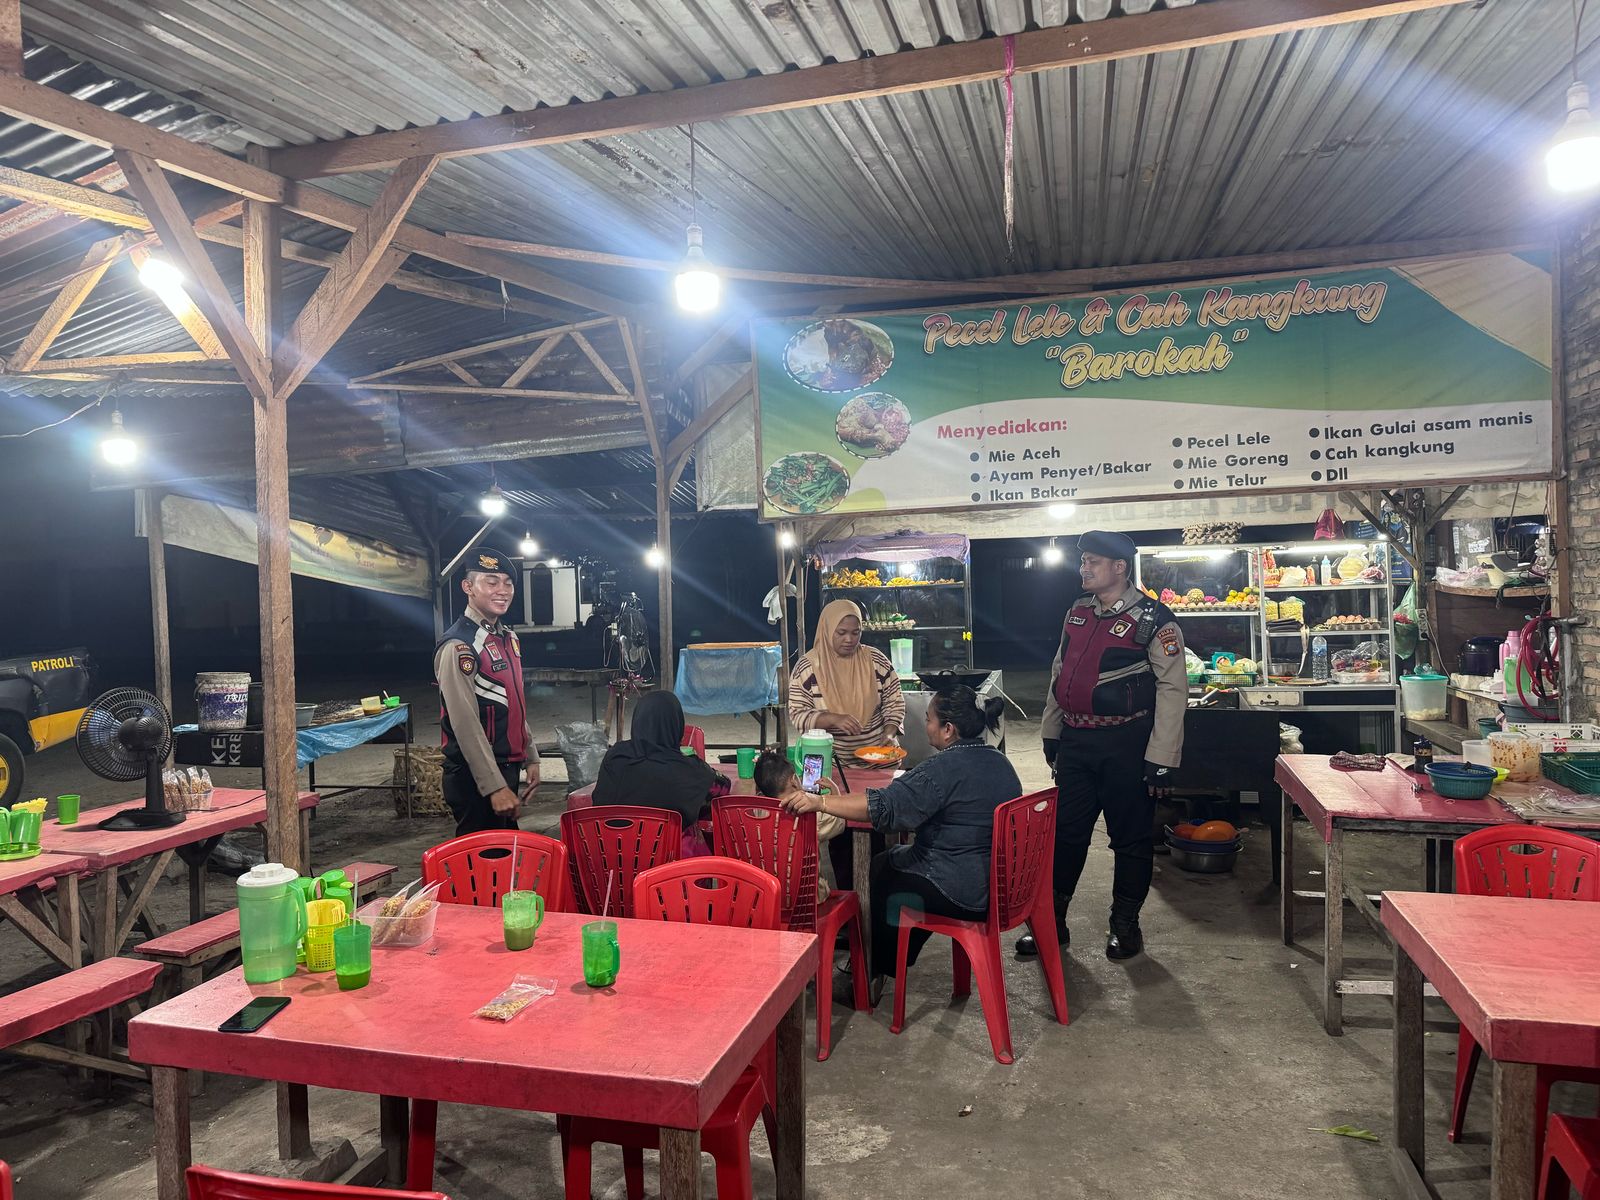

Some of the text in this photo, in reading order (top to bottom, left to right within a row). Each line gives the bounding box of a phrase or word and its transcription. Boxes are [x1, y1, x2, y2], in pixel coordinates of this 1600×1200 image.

[923, 278, 1388, 354] Pecel Lele & Cah Kangkung
[936, 419, 1068, 441] Menyediakan:
[1324, 411, 1533, 439] Ikan Gulai asam manis
[1187, 431, 1271, 449] Pecel Lele
[988, 446, 1061, 463] Mie Aceh
[1325, 441, 1455, 460] Cah kangkung
[1188, 454, 1288, 469] Mie Goreng
[989, 461, 1152, 484] Ayam Penyet/Bakar
[1189, 473, 1267, 489] Mie Telur
[1326, 467, 1348, 482] Dll
[990, 486, 1078, 502] Ikan Bakar
[31, 656, 74, 672] PATROLI
